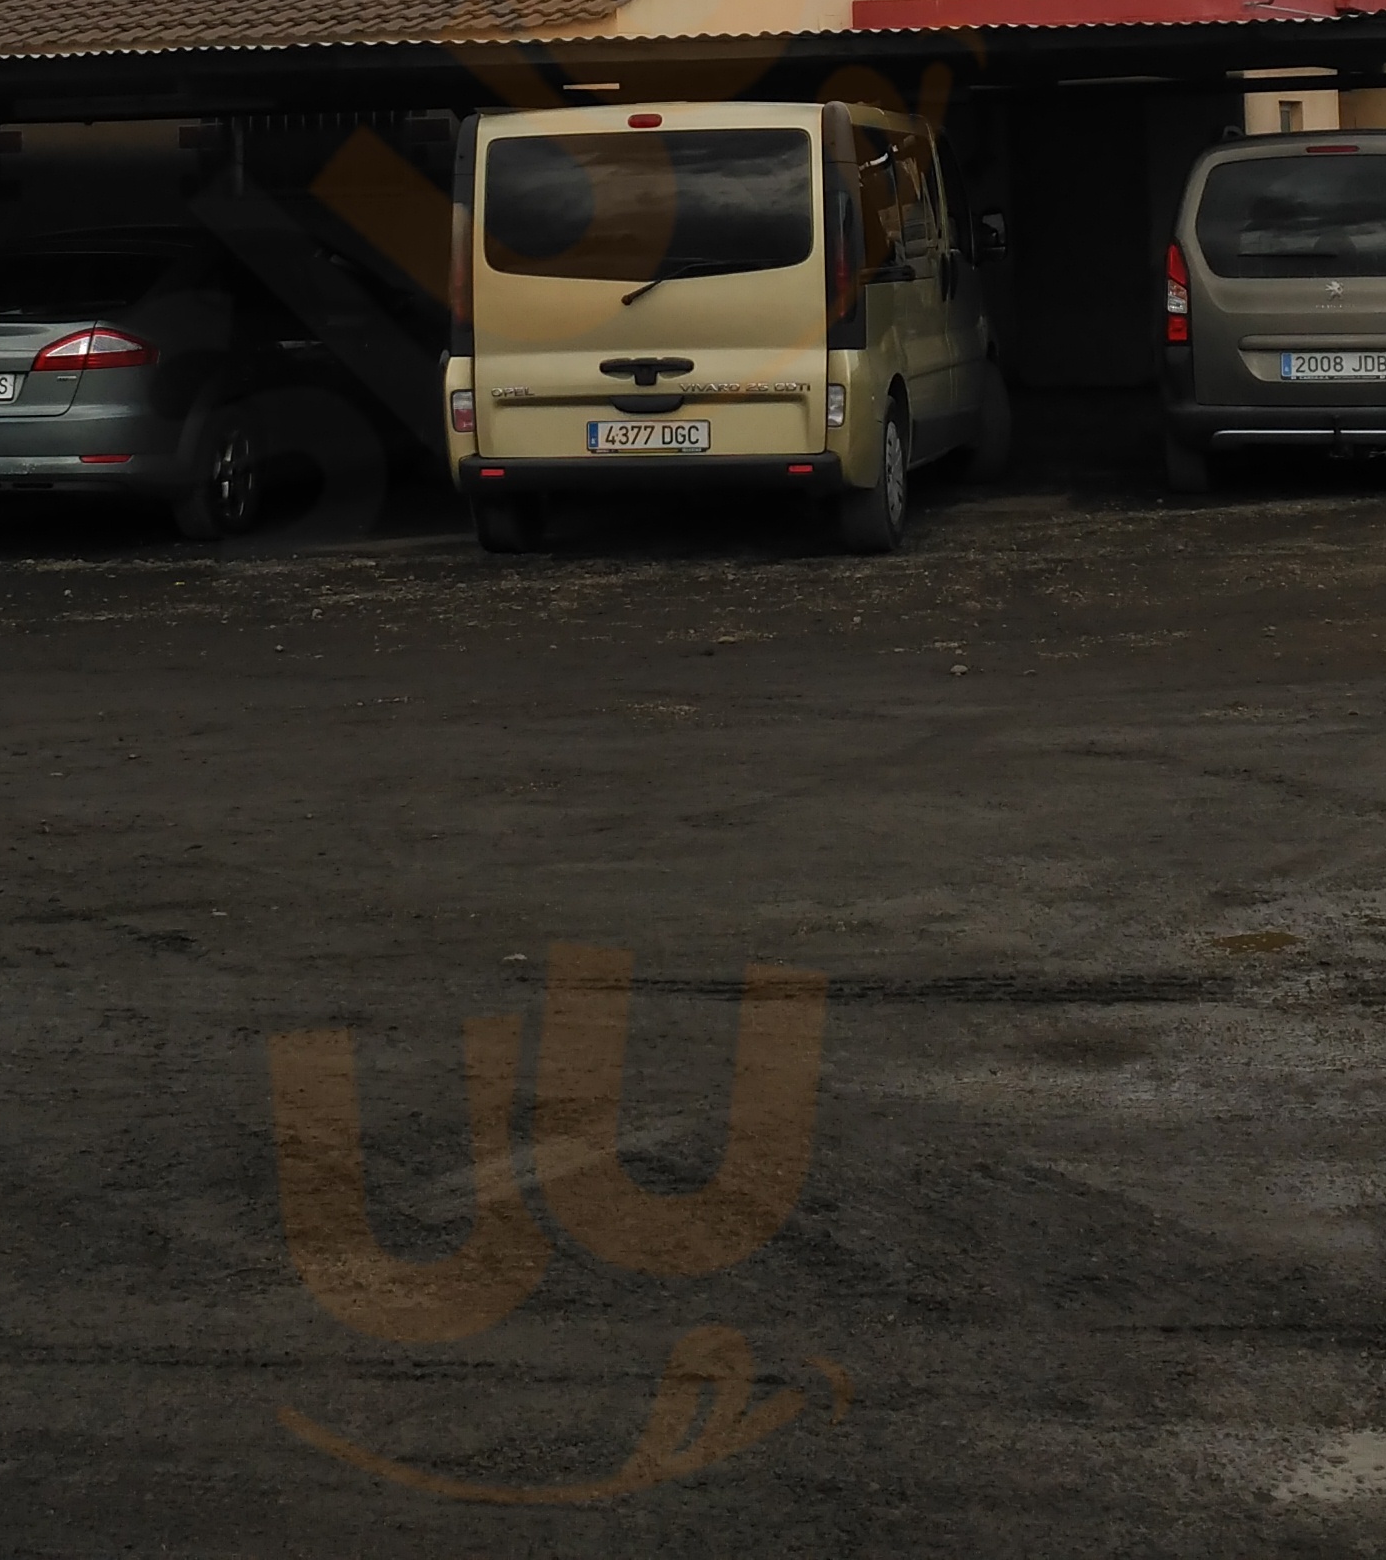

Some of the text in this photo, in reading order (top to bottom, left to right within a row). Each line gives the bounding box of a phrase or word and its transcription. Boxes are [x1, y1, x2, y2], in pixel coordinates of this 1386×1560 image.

[1295, 355, 1344, 373] 2008
[491, 387, 535, 397] OPEL
[679, 382, 741, 393] VIVARO
[605, 425, 700, 446] 4377 DGC
